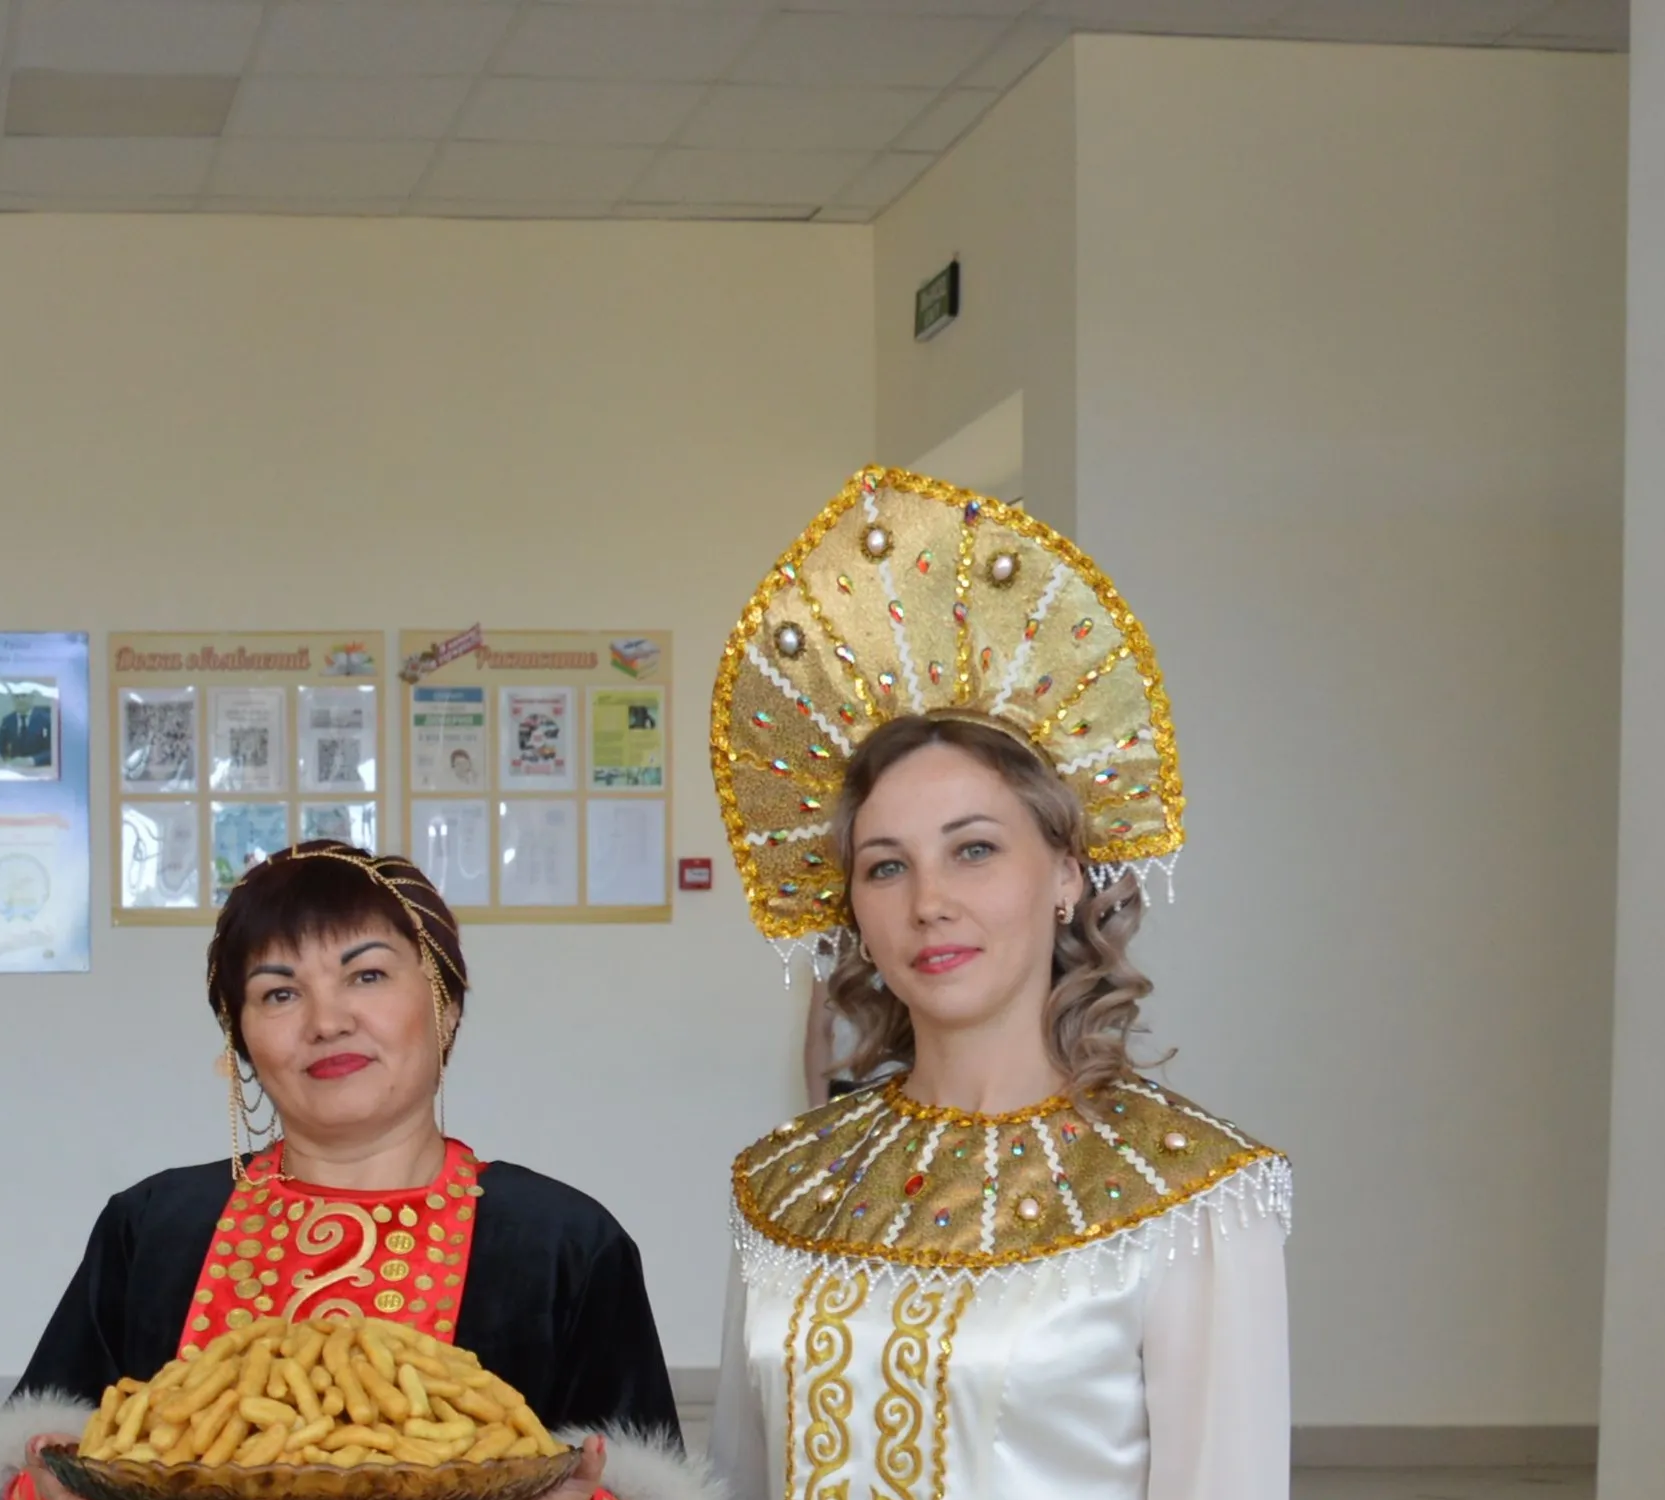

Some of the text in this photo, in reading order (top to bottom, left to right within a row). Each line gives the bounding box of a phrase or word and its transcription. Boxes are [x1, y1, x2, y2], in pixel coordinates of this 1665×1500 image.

[115, 645, 311, 672] Доска объявлений
[475, 644, 597, 671] Расписание
